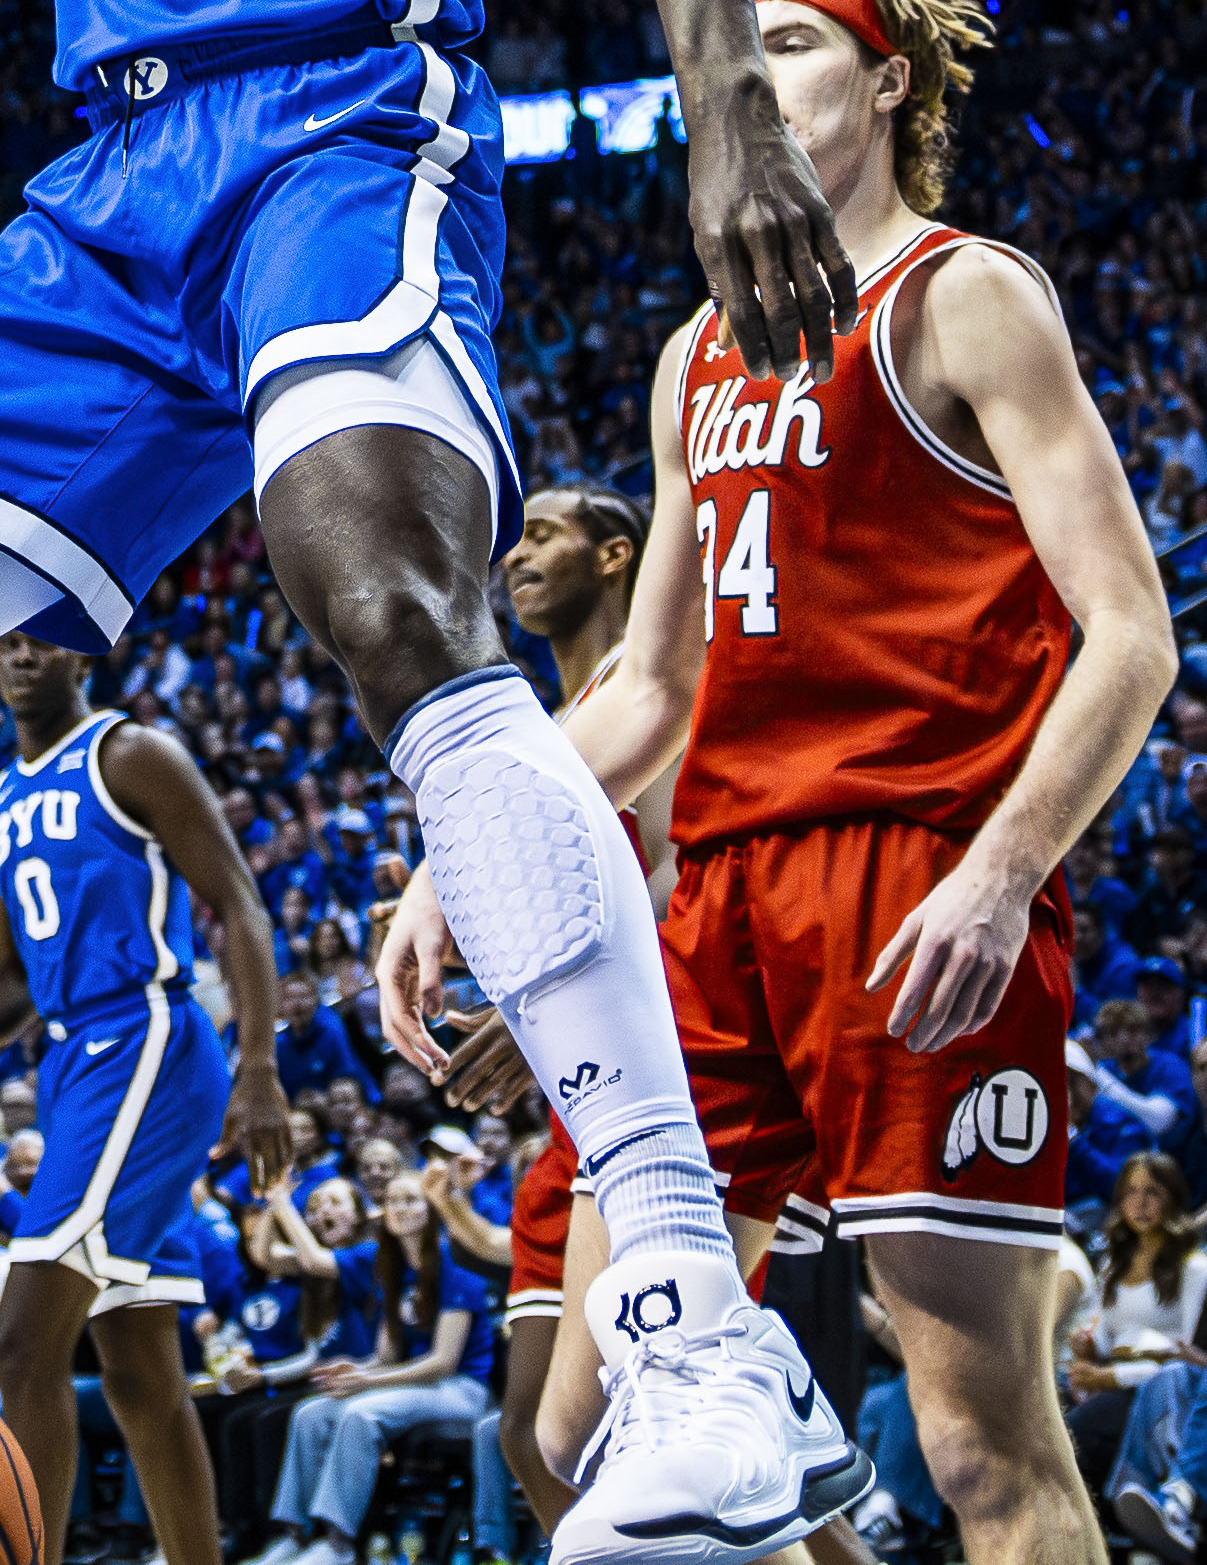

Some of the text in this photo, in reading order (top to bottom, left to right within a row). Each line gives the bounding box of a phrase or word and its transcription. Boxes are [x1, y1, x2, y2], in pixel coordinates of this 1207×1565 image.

[688, 360, 832, 486] Utah
[14, 856, 60, 941] 0
[991, 1083, 1039, 1151] U
